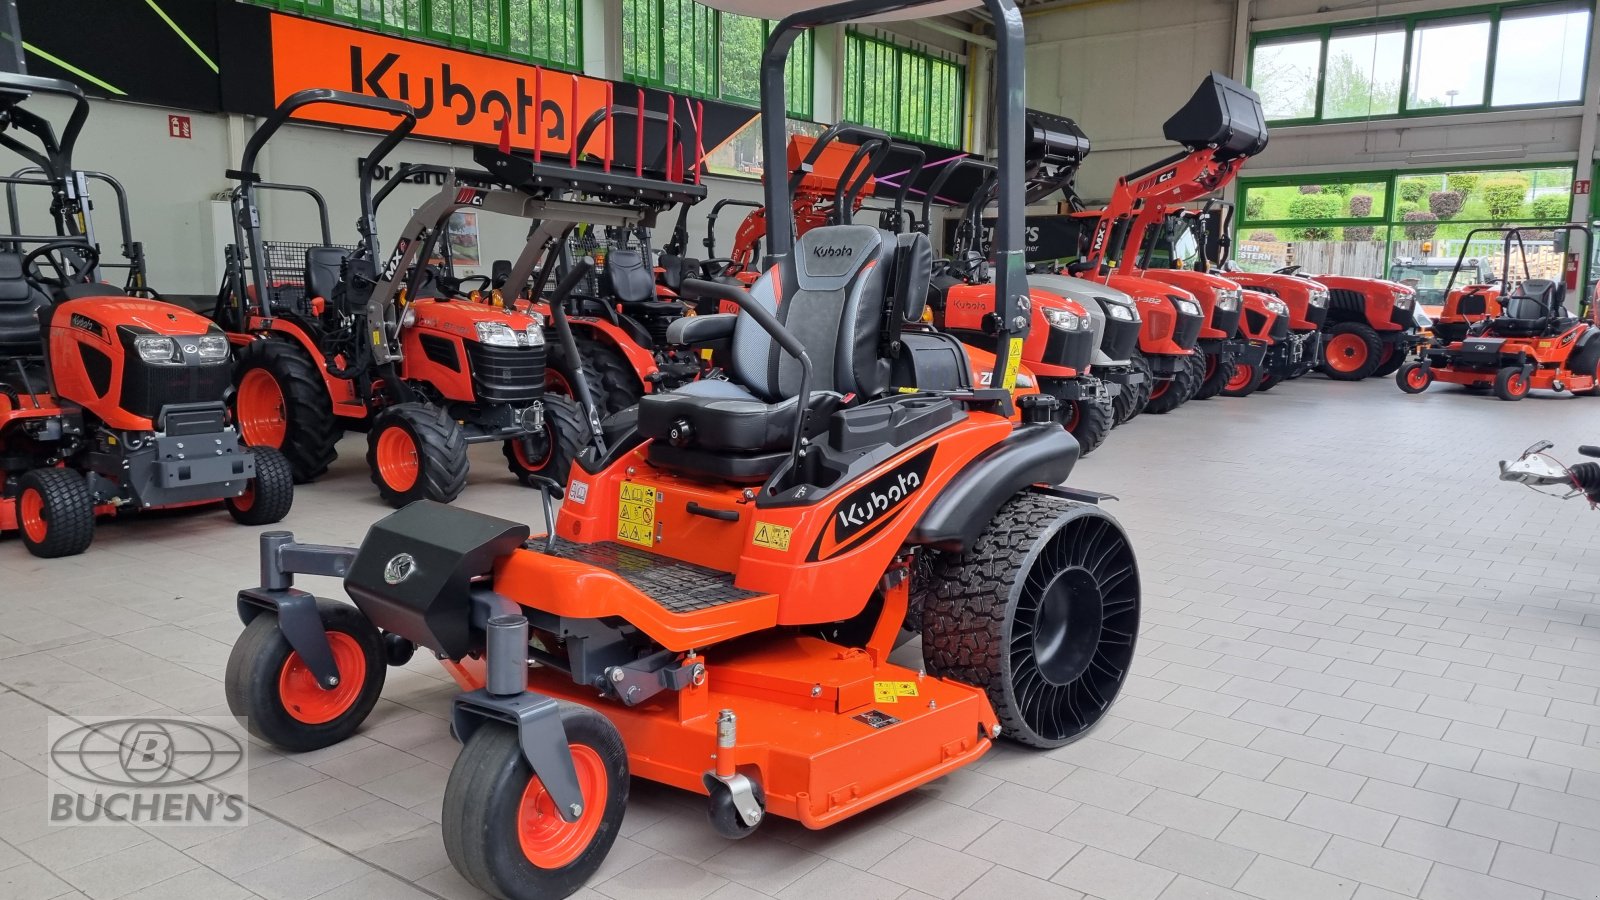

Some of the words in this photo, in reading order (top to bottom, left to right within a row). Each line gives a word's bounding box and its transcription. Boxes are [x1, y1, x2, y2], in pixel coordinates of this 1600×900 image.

[350, 45, 565, 141] Kubota
[1094, 229, 1106, 251] MX
[1238, 244, 1260, 252] HEN
[813, 244, 853, 257] Kubota
[385, 248, 403, 280] MX
[953, 299, 987, 310] Kubota
[73, 314, 93, 330] Kubota
[838, 471, 921, 528] Kubota
